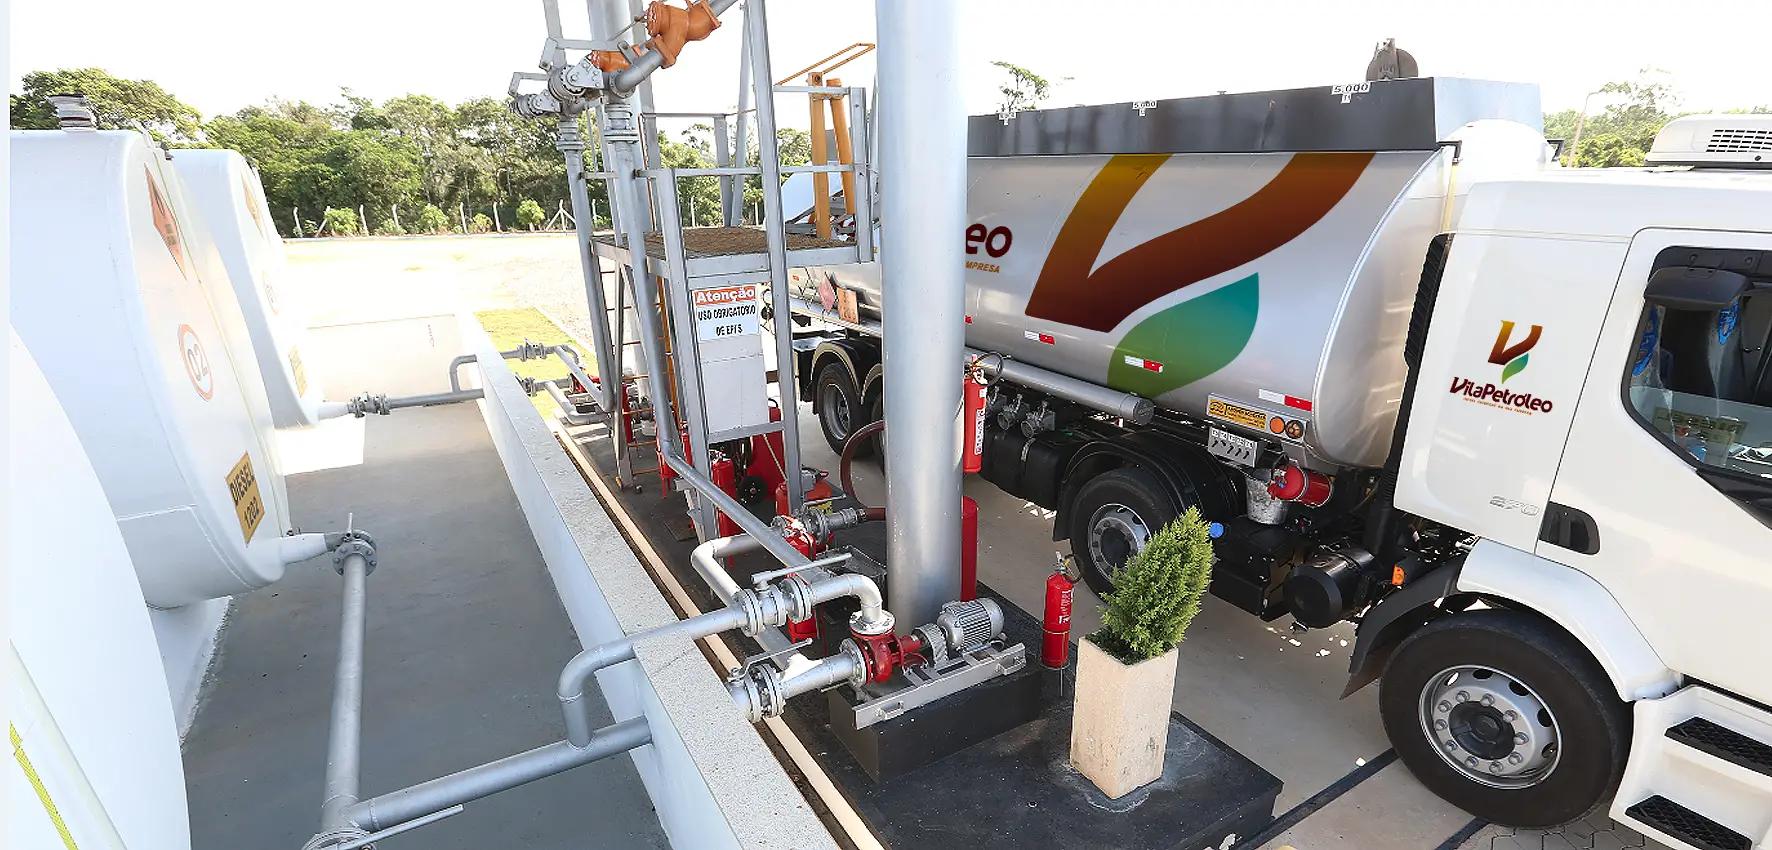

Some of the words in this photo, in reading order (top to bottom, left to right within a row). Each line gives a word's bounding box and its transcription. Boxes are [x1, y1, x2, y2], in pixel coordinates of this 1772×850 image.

[1333, 83, 1369, 93] 5.000
[965, 261, 1001, 273] MPRESA
[696, 286, 755, 303] Atenção
[698, 309, 712, 321] USO
[1449, 376, 1553, 413] VilaPetróleo
[229, 462, 255, 507] DIESEL
